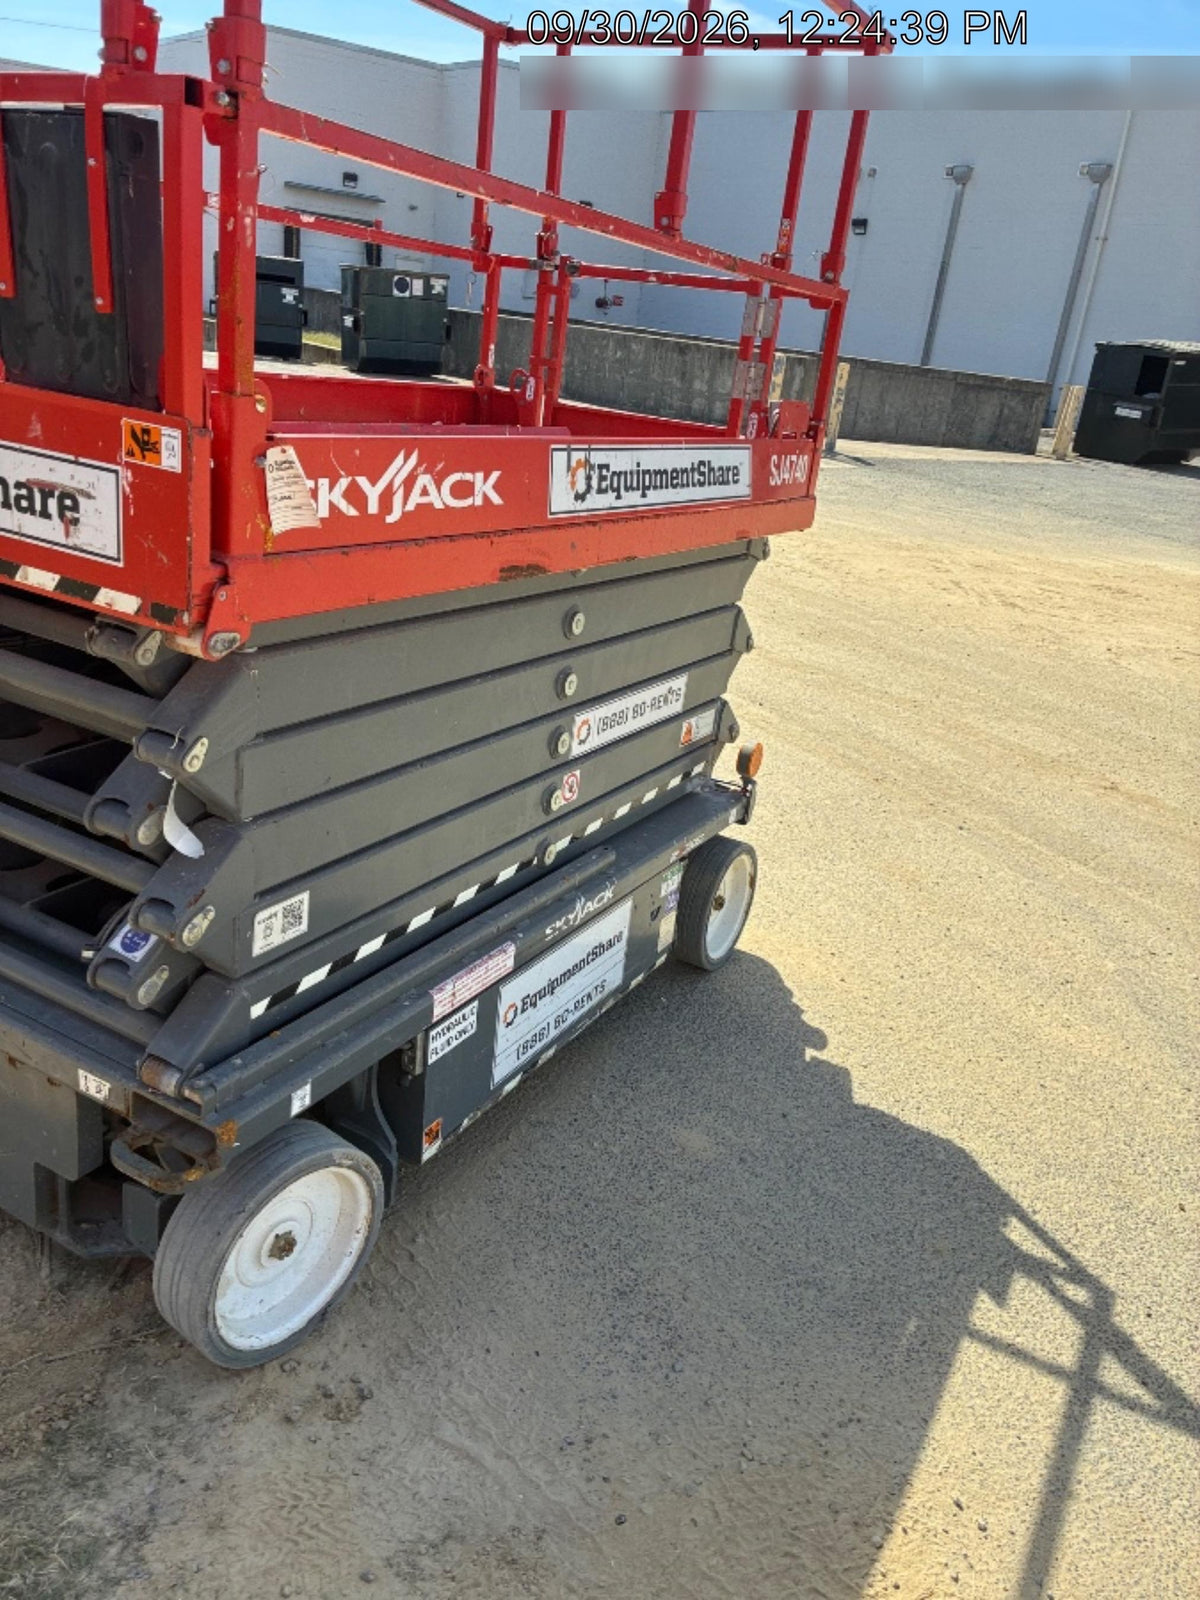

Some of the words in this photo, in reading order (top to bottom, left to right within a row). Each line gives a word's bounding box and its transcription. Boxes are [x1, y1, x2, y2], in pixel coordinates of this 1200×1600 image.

[305, 448, 504, 523] KYJACK
[595, 459, 741, 500] EquipmentShare
[520, 930, 624, 1014] EquipmentShare
